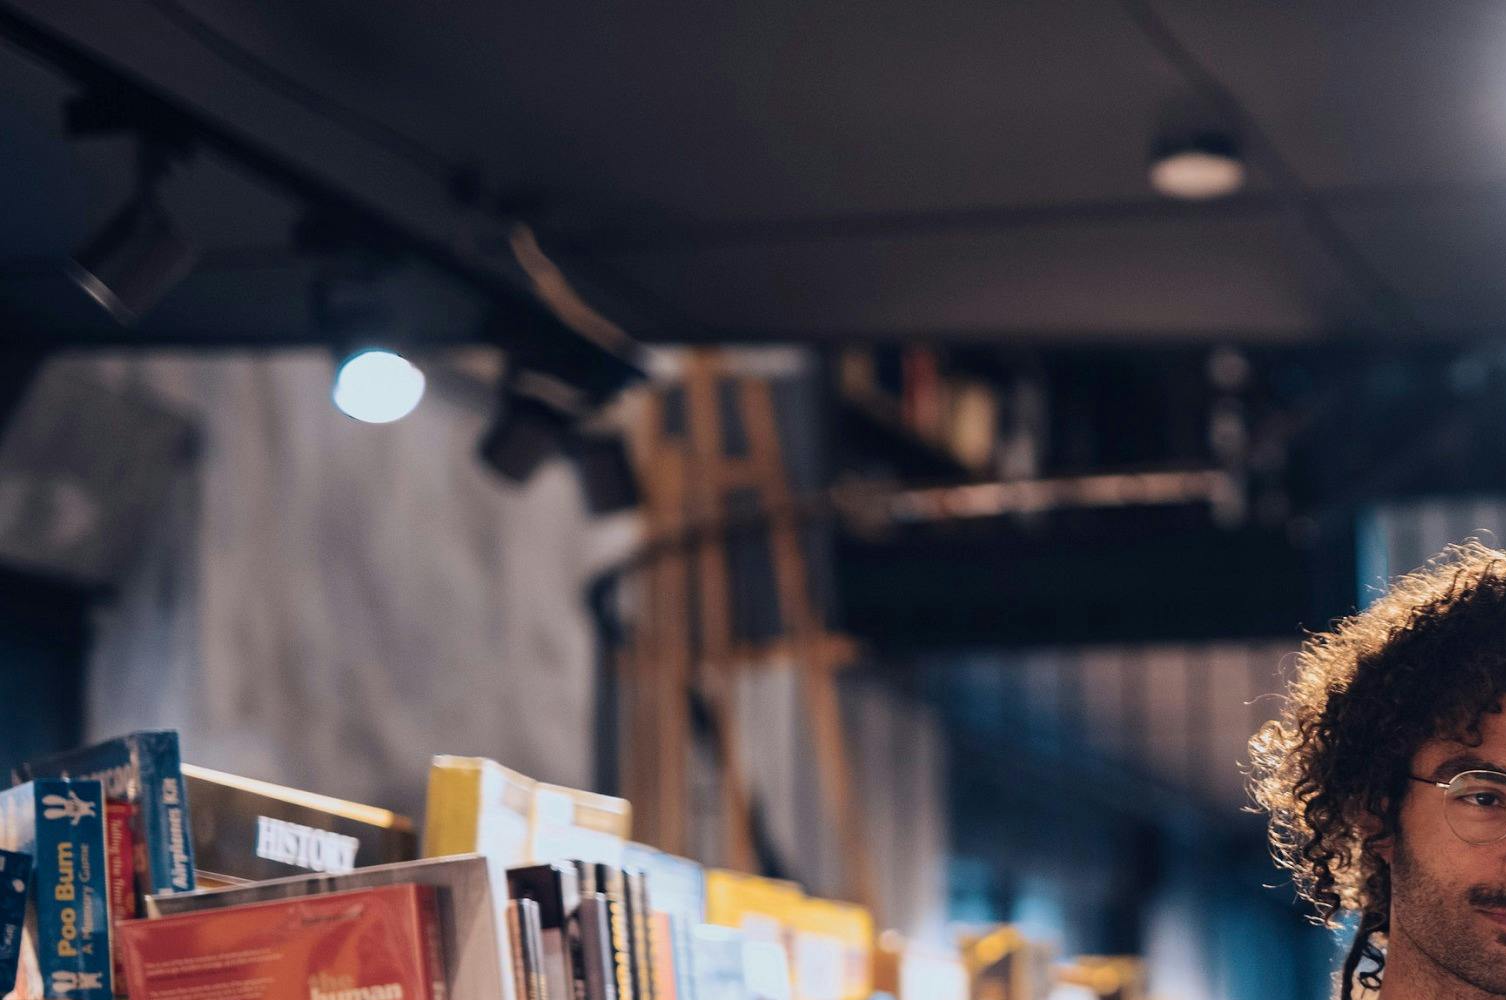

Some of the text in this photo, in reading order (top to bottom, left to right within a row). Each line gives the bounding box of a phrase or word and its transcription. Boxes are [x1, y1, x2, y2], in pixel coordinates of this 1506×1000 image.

[257, 816, 360, 876] HISTORY
[55, 842, 77, 957] Poo Bum
[83, 943, 93, 955] A
